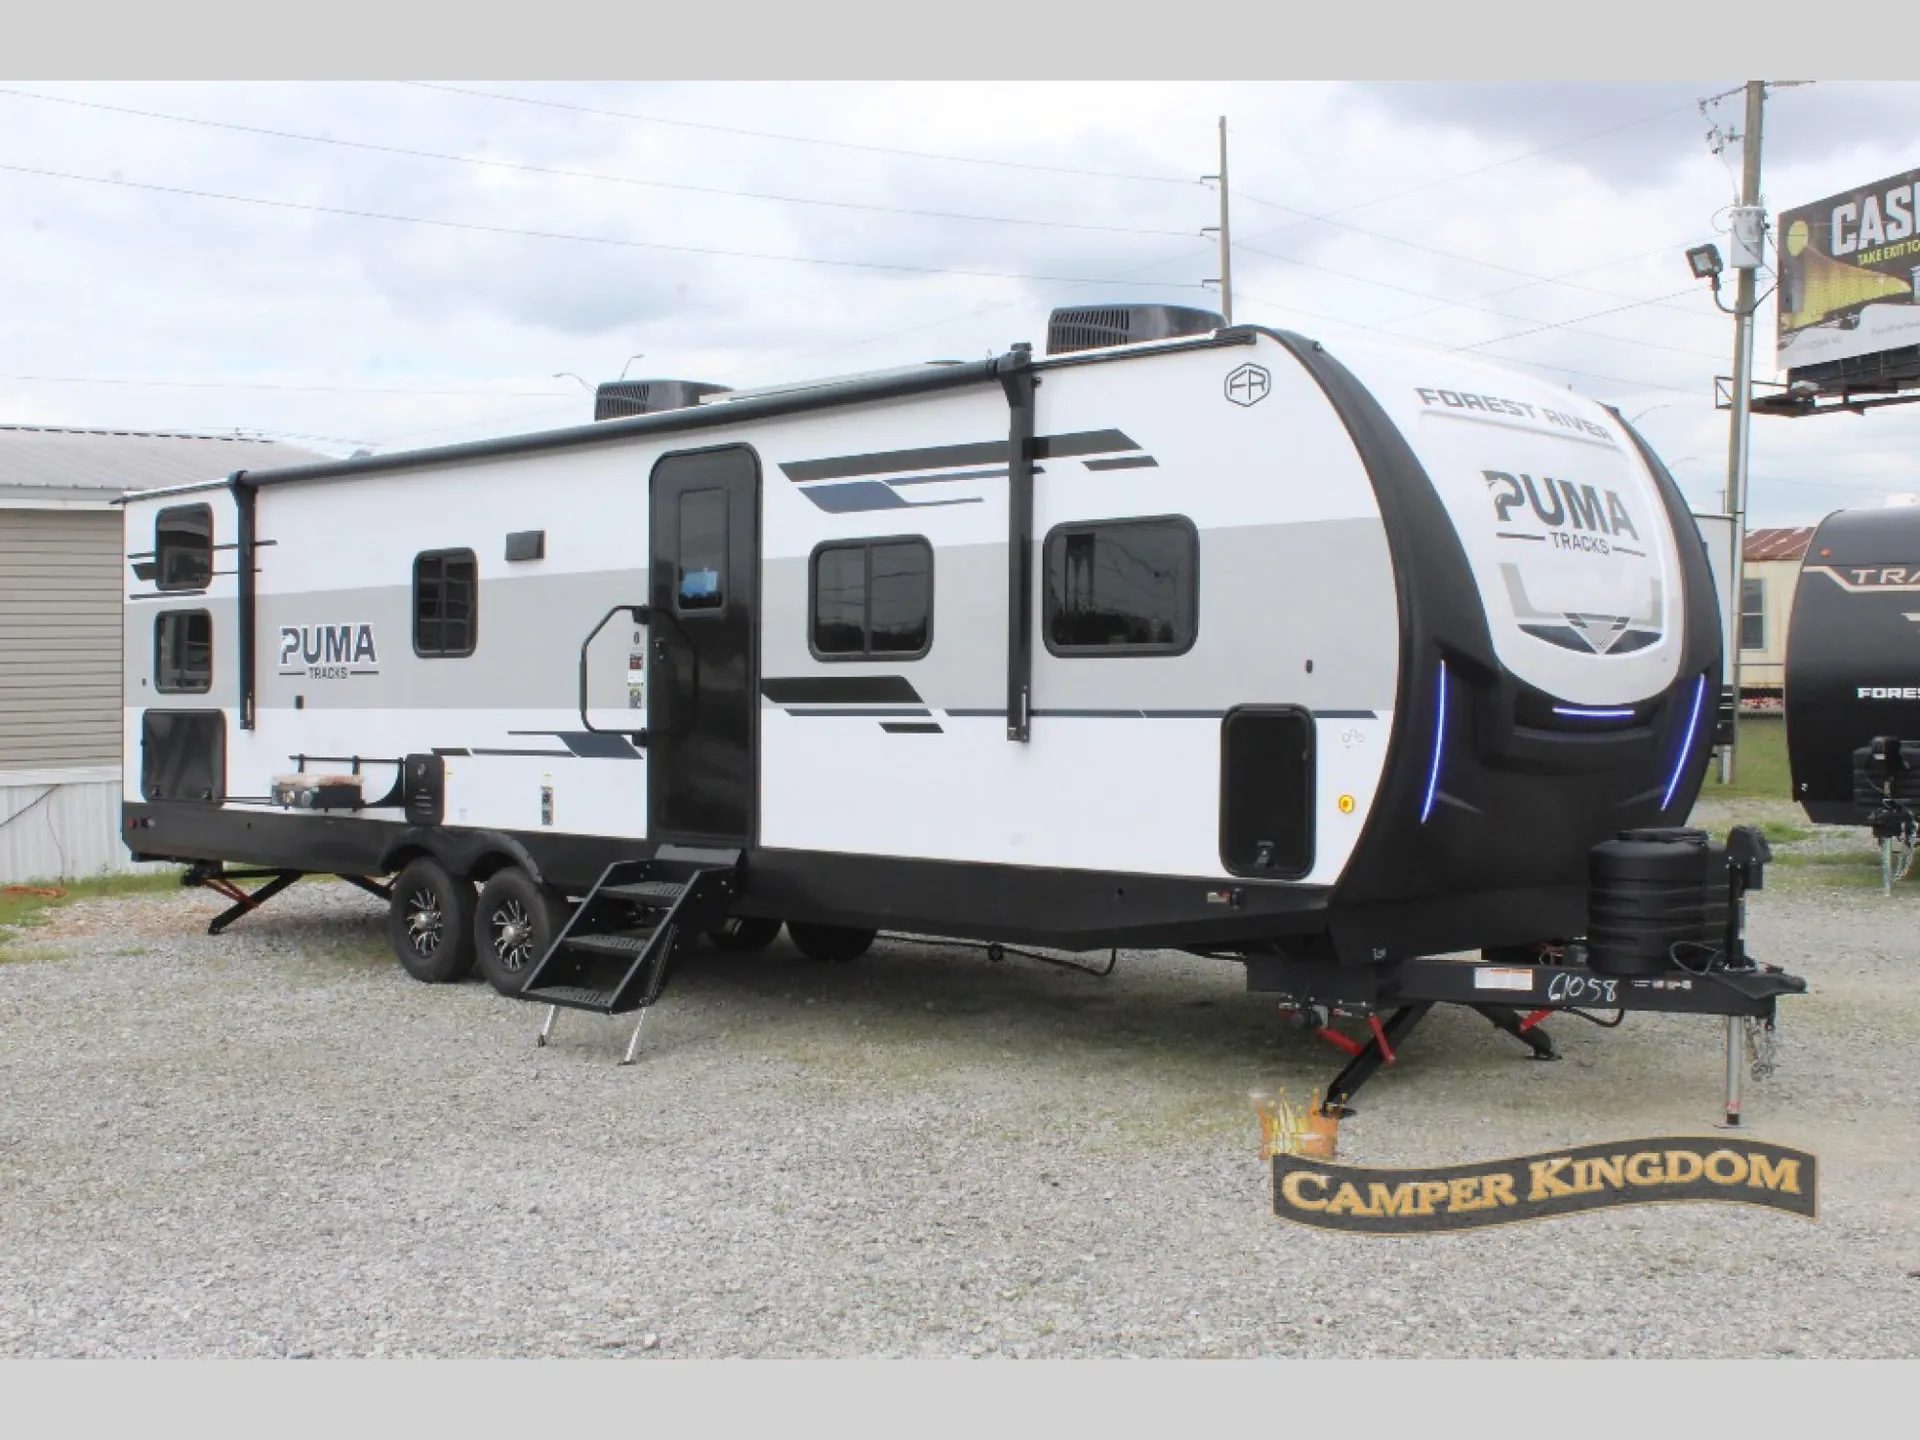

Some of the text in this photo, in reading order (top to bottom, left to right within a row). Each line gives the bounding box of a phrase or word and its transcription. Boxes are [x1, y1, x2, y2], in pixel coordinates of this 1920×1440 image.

[1832, 181, 1920, 257] CAS
[1857, 248, 1882, 266] TAKE
[1884, 244, 1904, 260] EXIT
[1414, 387, 1616, 443] FOREST RIVER
[1481, 470, 1640, 541] PUMA
[1549, 532, 1610, 555] TRACKS
[279, 623, 378, 666] PUMA
[308, 666, 348, 680] TRACKS
[1857, 687, 1920, 699] FORE
